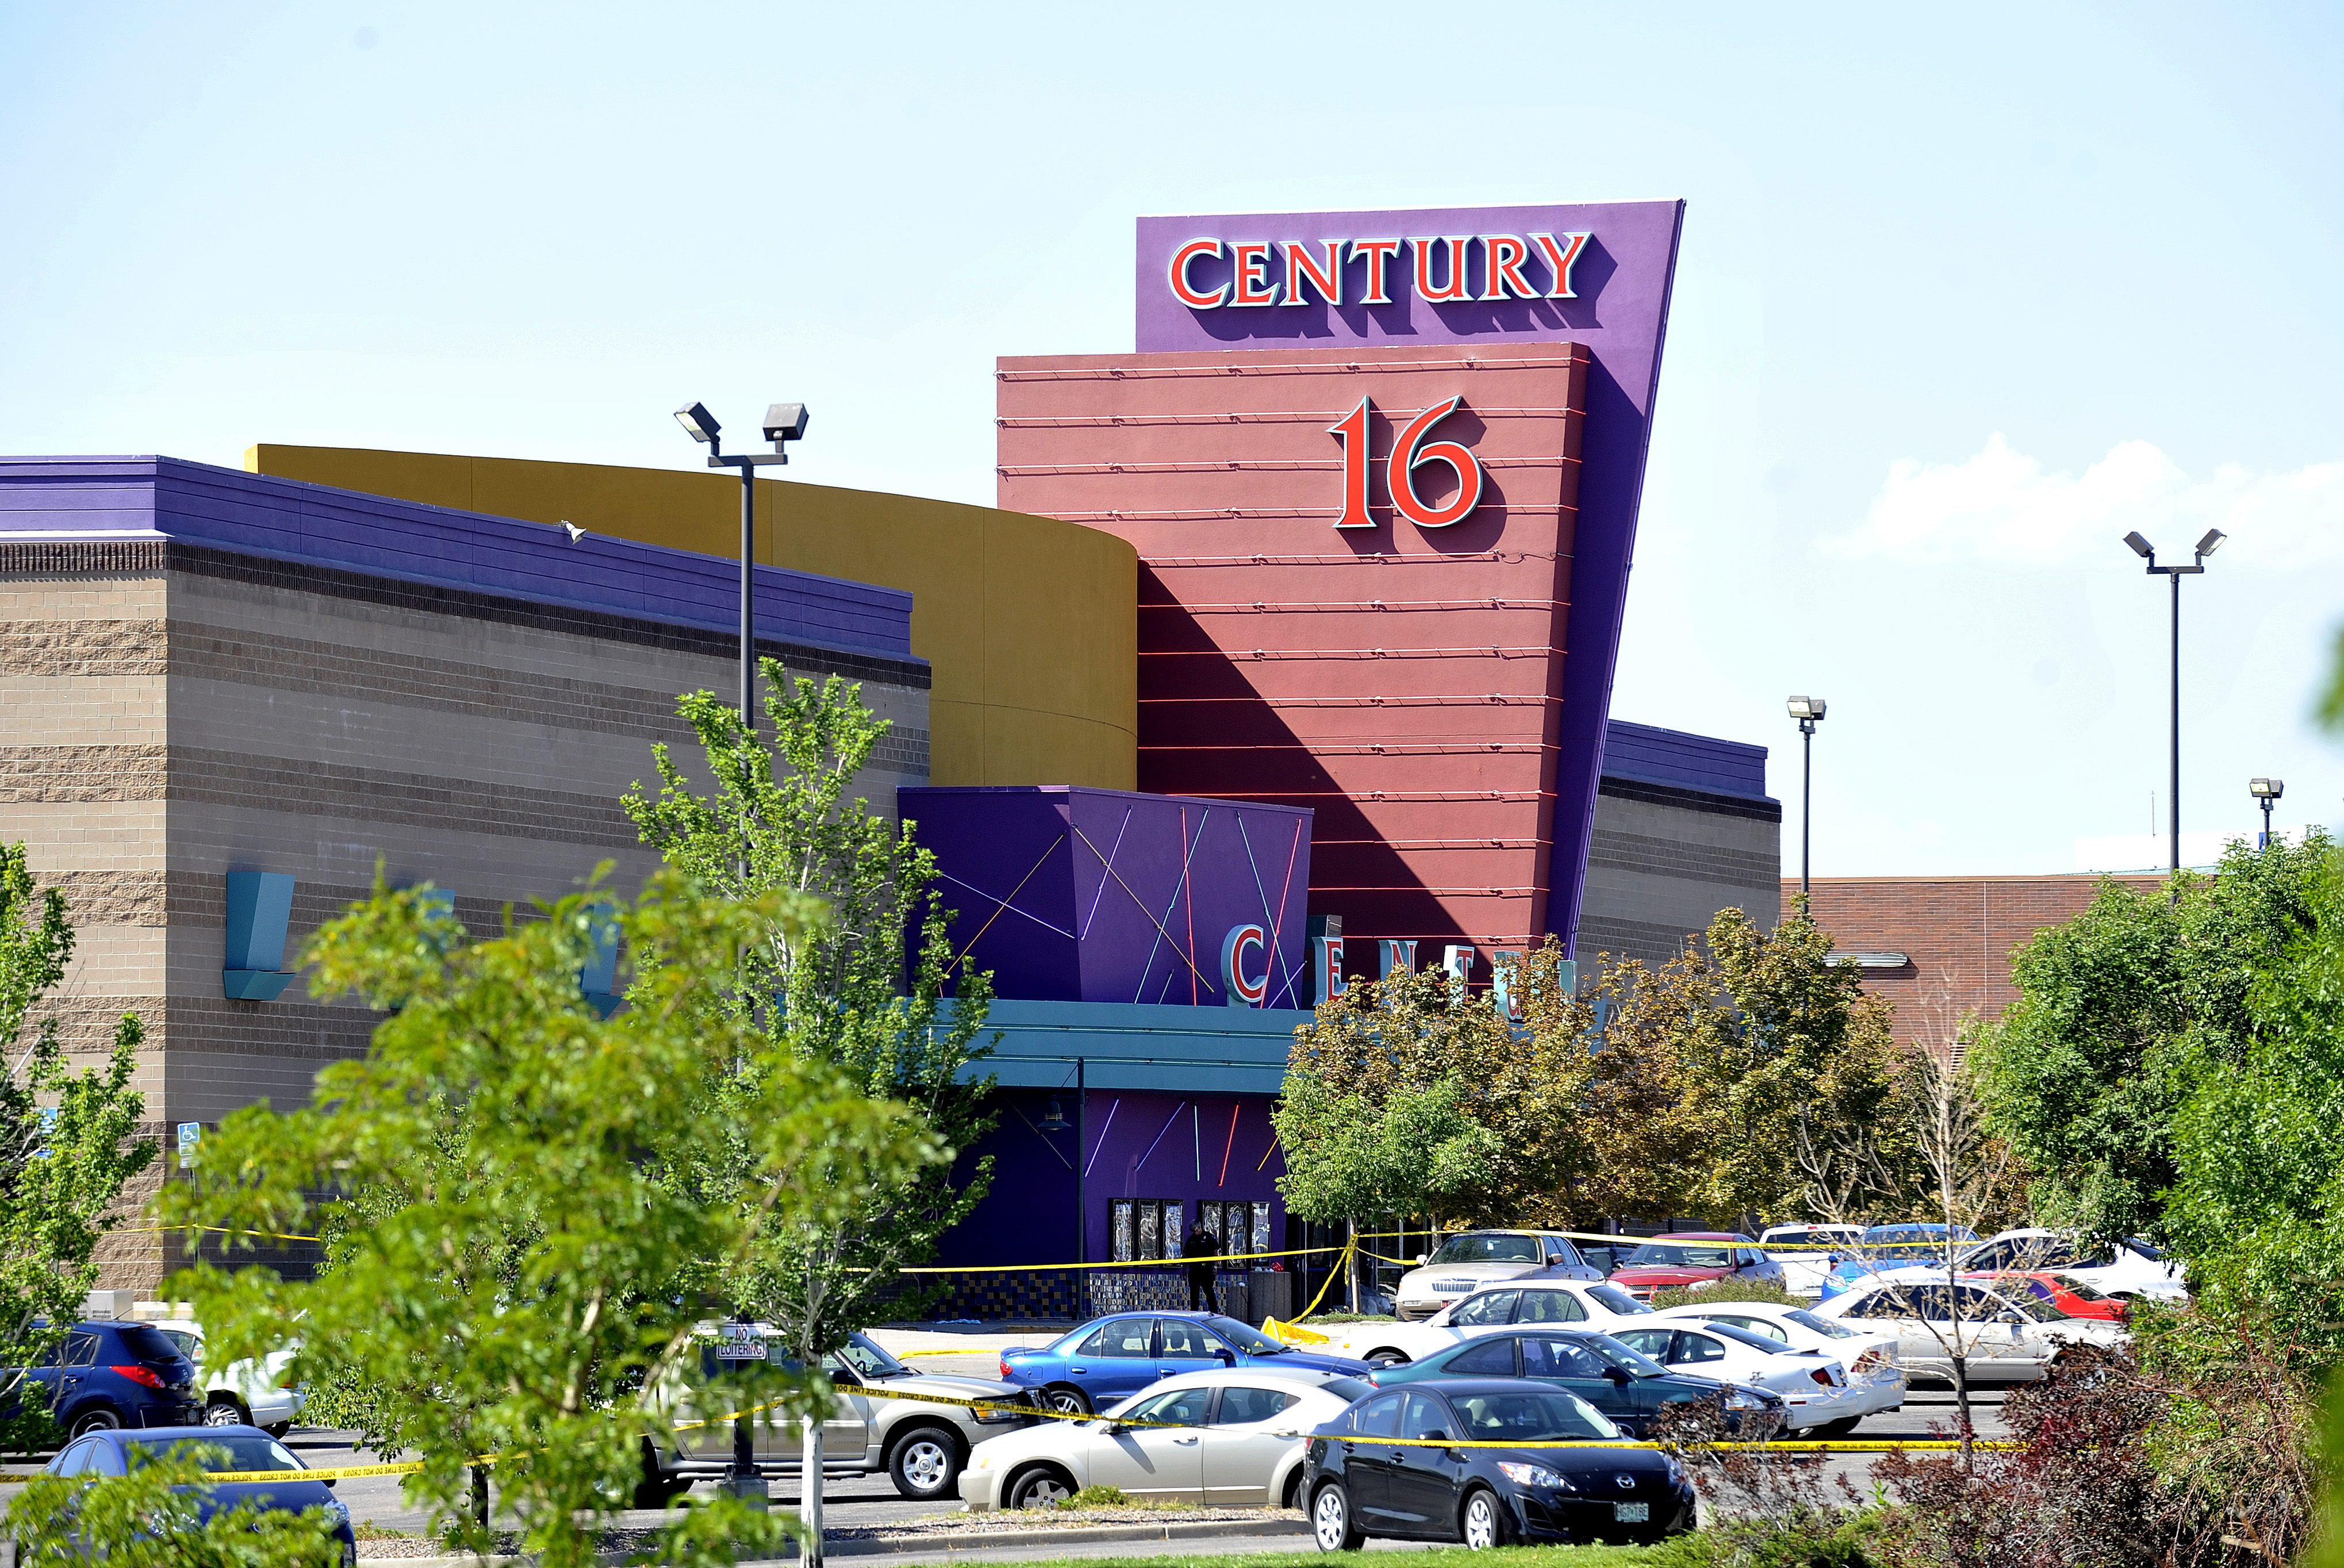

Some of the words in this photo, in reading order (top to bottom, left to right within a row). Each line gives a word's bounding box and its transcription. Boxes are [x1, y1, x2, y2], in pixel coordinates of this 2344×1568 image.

[1167, 231, 1592, 310] CENTURY
[1325, 394, 1483, 528] 16
[1220, 924, 1578, 1021] CENTU
[736, 1328, 747, 1340] NO
[720, 1343, 762, 1355] LOITERING
[850, 1386, 865, 1395] LINE
[866, 1388, 889, 1397] POLICE
[897, 1392, 919, 1401] CROSS
[945, 1397, 961, 1405] LINE
[962, 1400, 985, 1408] POLICE
